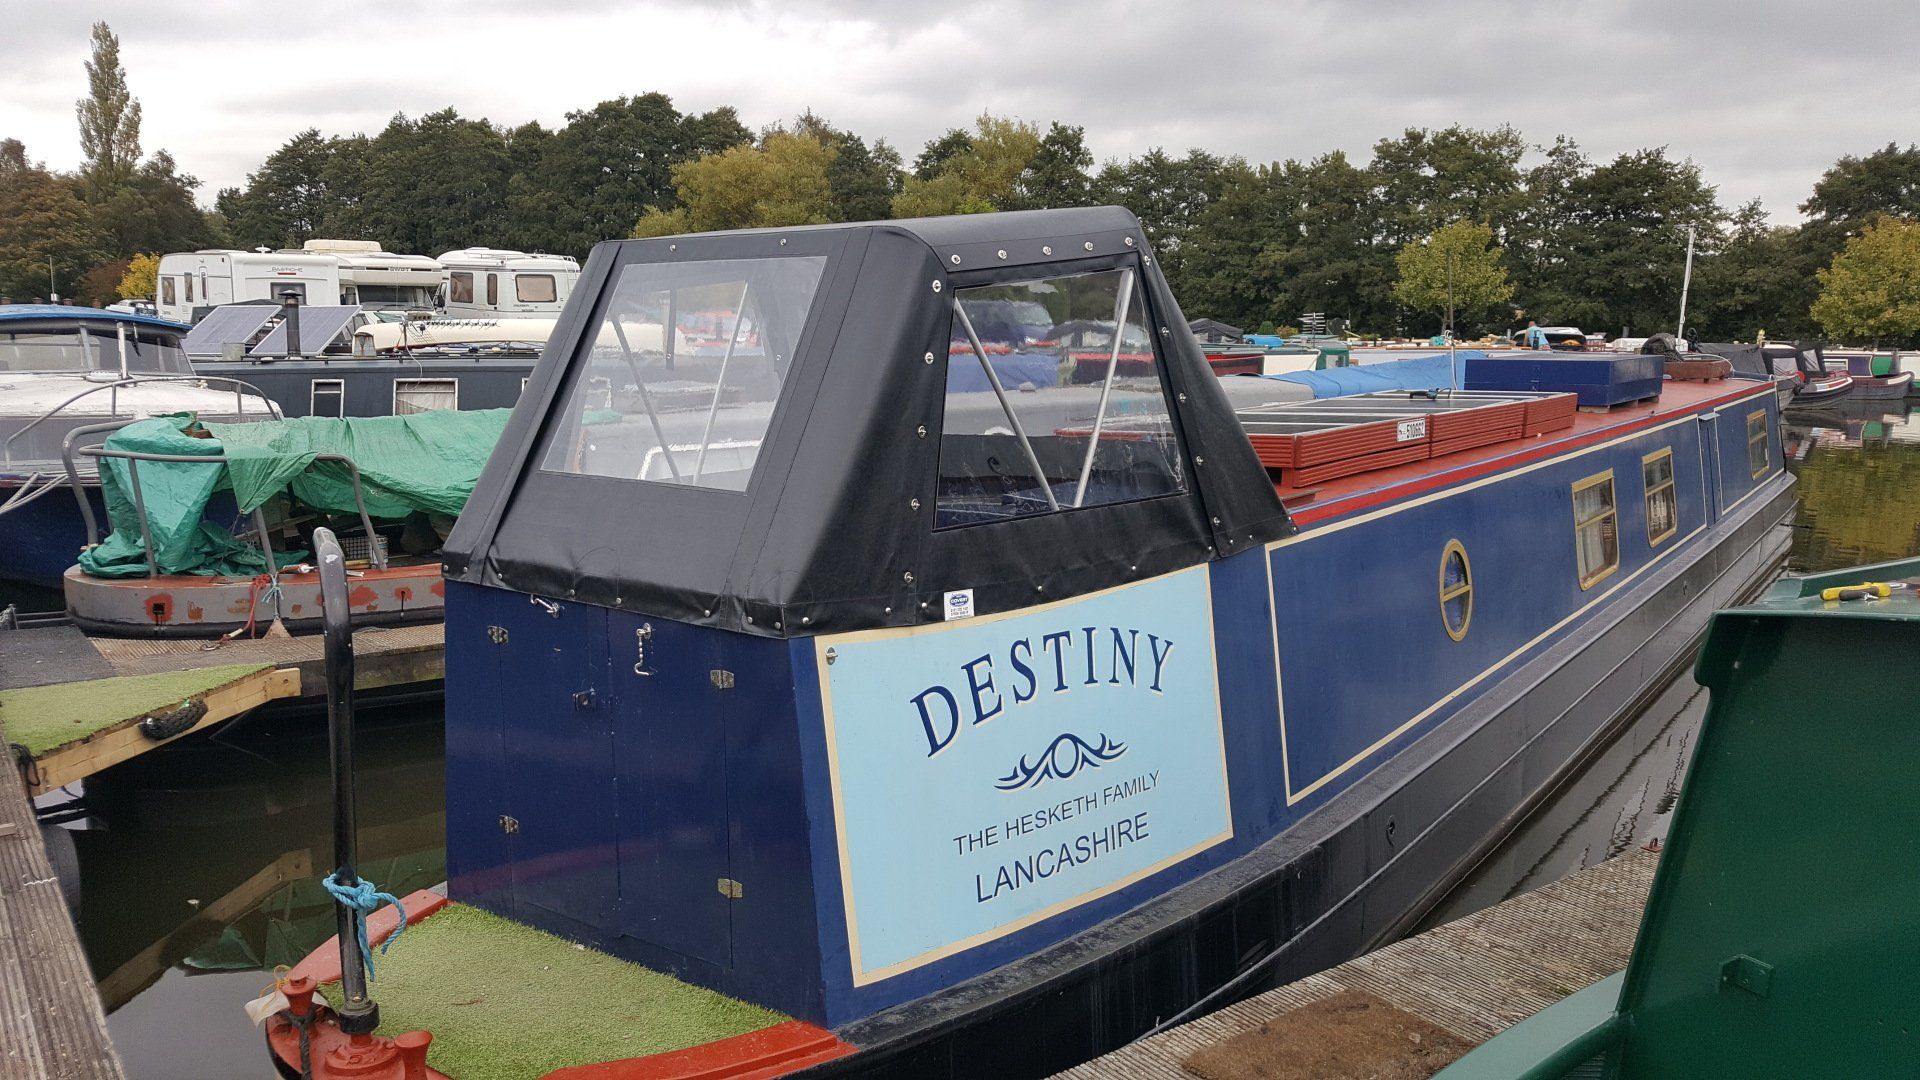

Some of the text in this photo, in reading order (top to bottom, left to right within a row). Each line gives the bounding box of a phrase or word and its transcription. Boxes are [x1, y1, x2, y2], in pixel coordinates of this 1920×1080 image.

[910, 627, 1174, 758] DESTINY
[953, 769, 1160, 856] THE HESKETH FAMILY
[976, 811, 1150, 903] LANCASHIRE
